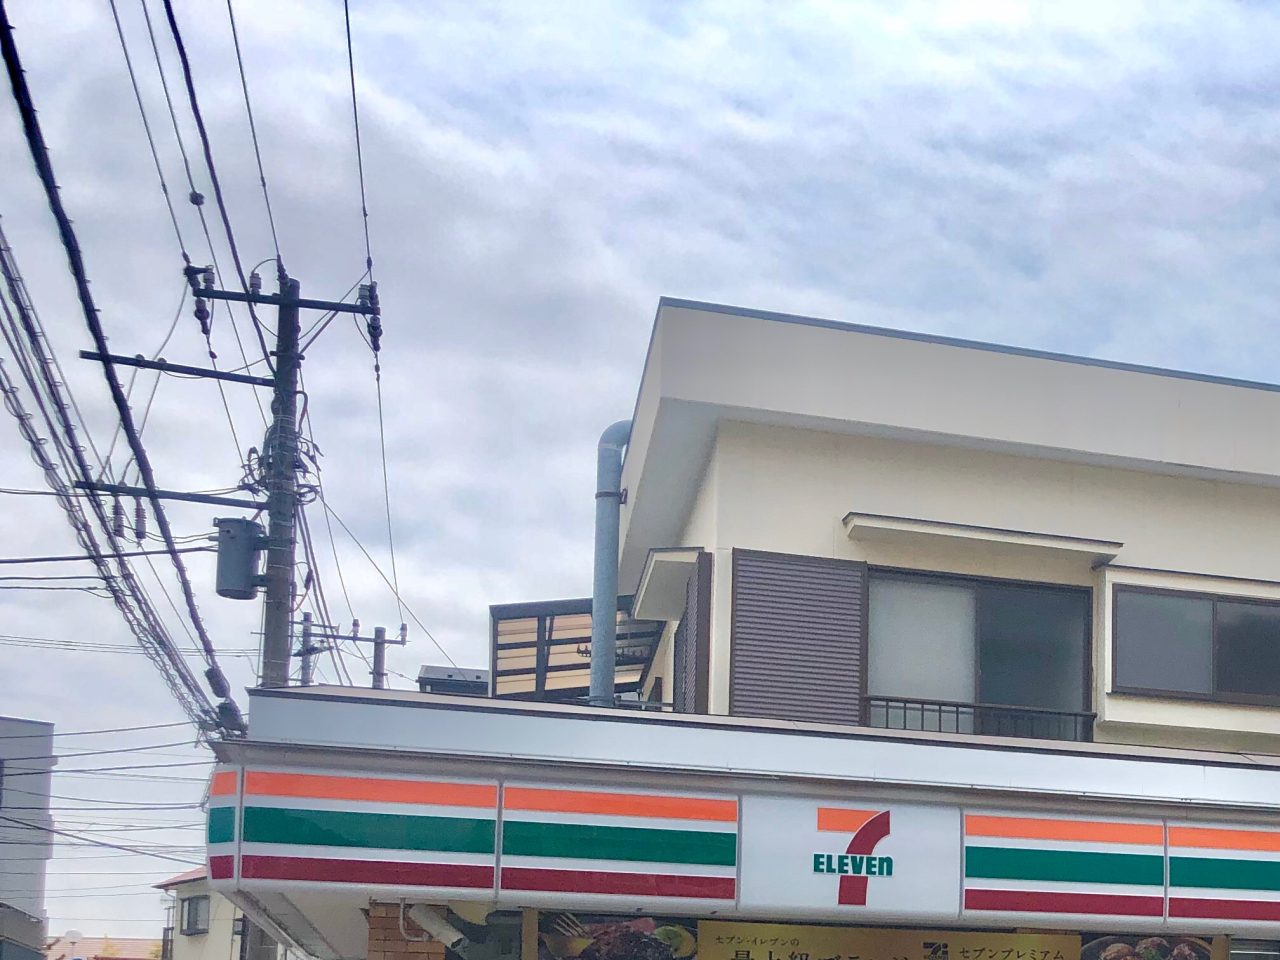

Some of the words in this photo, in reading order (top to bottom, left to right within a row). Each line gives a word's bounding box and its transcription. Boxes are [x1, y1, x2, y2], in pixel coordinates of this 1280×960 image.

[960, 947, 1064, 960] セブンプレミアム
